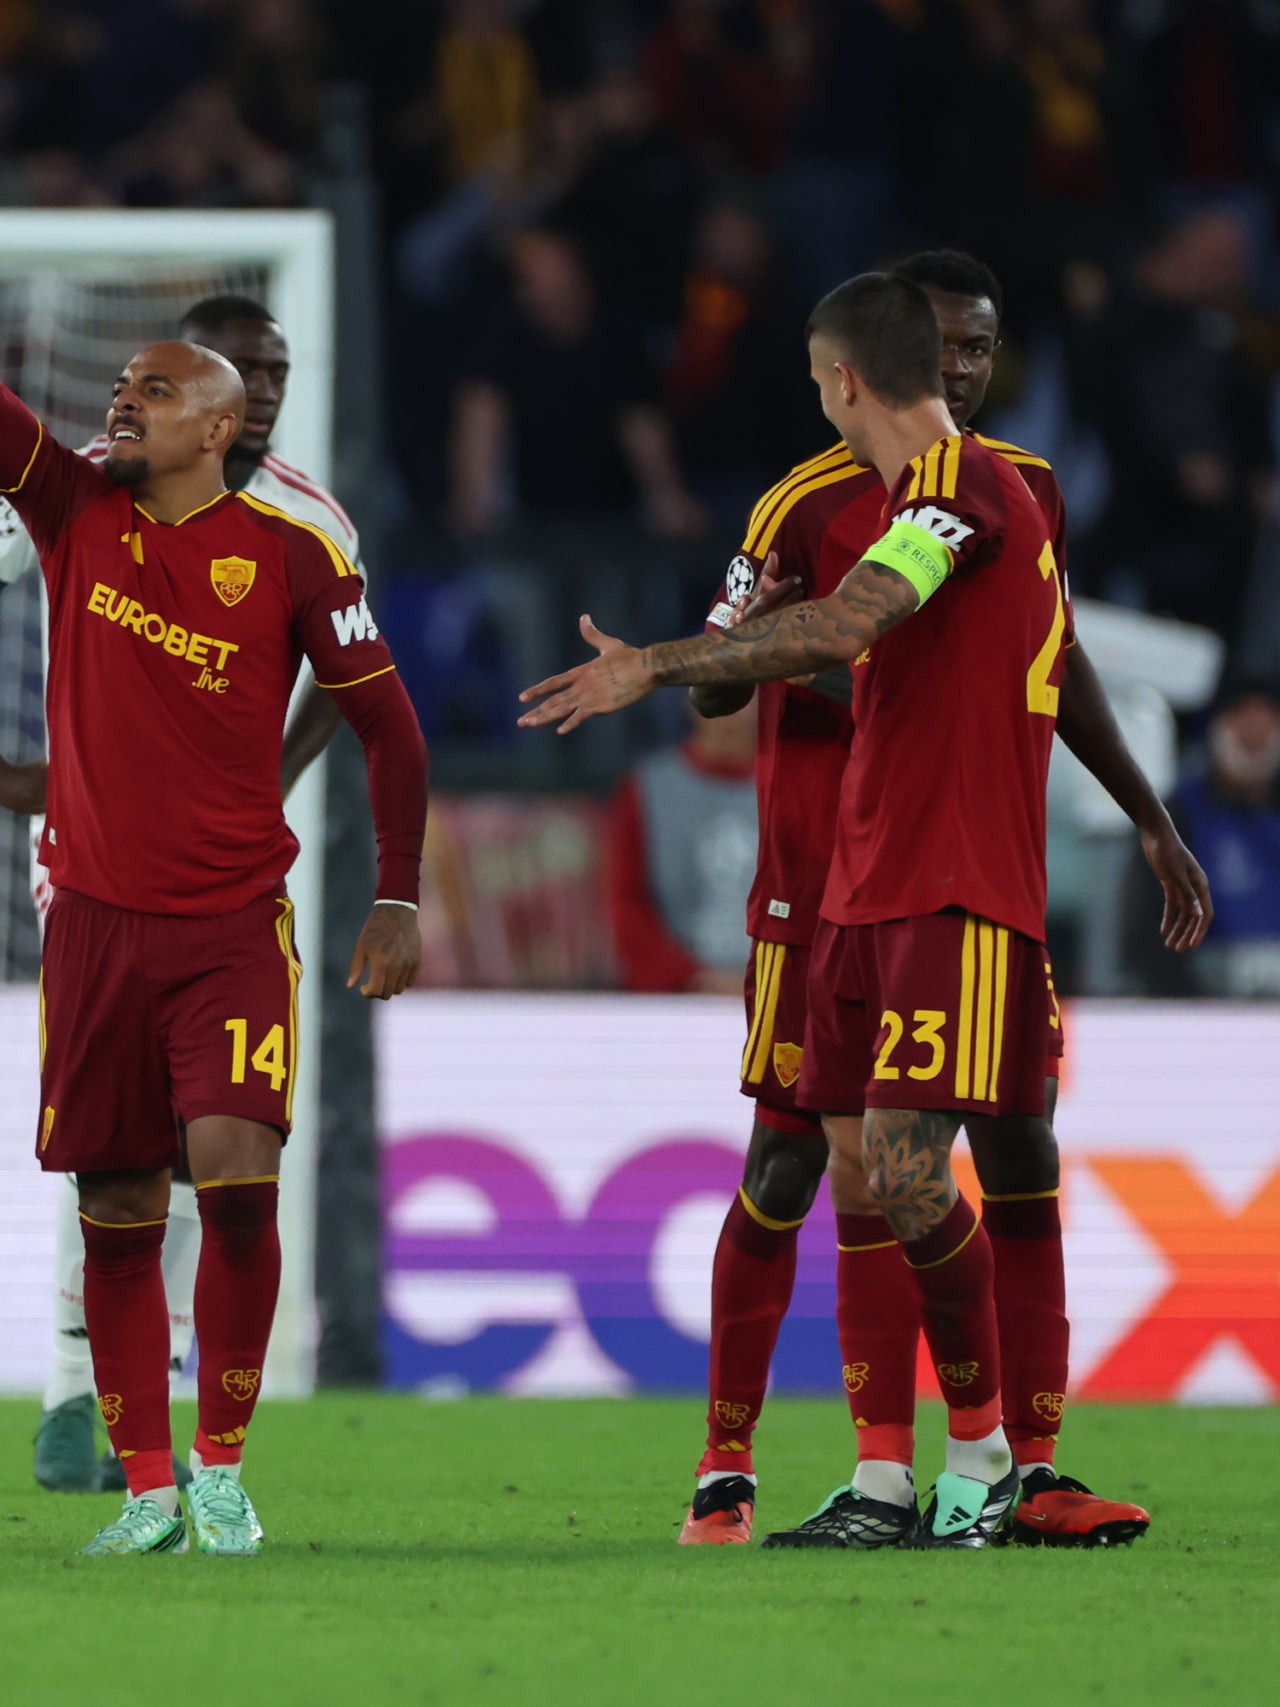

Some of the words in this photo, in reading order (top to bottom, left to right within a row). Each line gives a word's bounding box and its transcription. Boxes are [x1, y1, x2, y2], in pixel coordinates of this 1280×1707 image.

[87, 582, 240, 671] EUROBET
[225, 1019, 286, 1092] 14
[874, 1009, 947, 1081] 23
